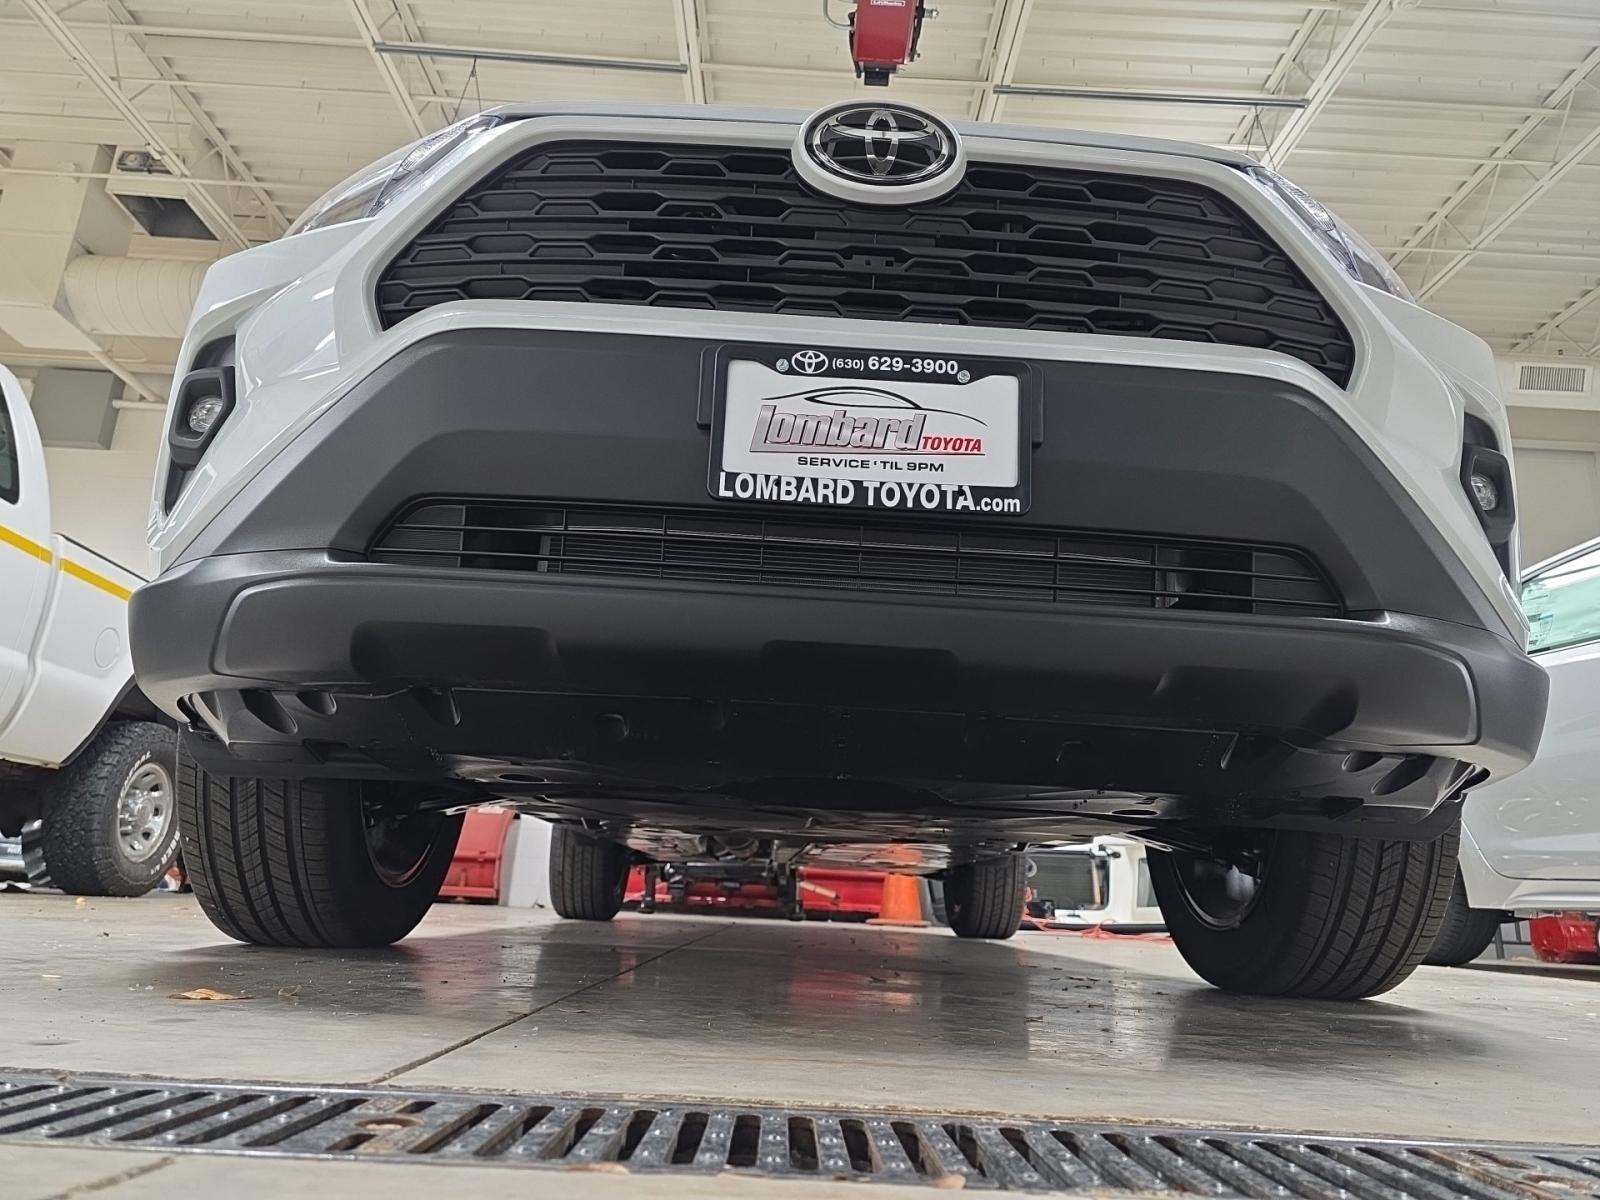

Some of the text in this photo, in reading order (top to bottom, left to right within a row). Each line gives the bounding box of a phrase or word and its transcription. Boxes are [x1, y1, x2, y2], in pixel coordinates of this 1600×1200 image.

[832, 356, 959, 375] (630) 629-3900
[922, 436, 982, 452] TOYOTA
[798, 456, 870, 469] SERVICE
[907, 462, 944, 472] 9PM
[718, 471, 1021, 513] LOMBARD TOYOTA.com
